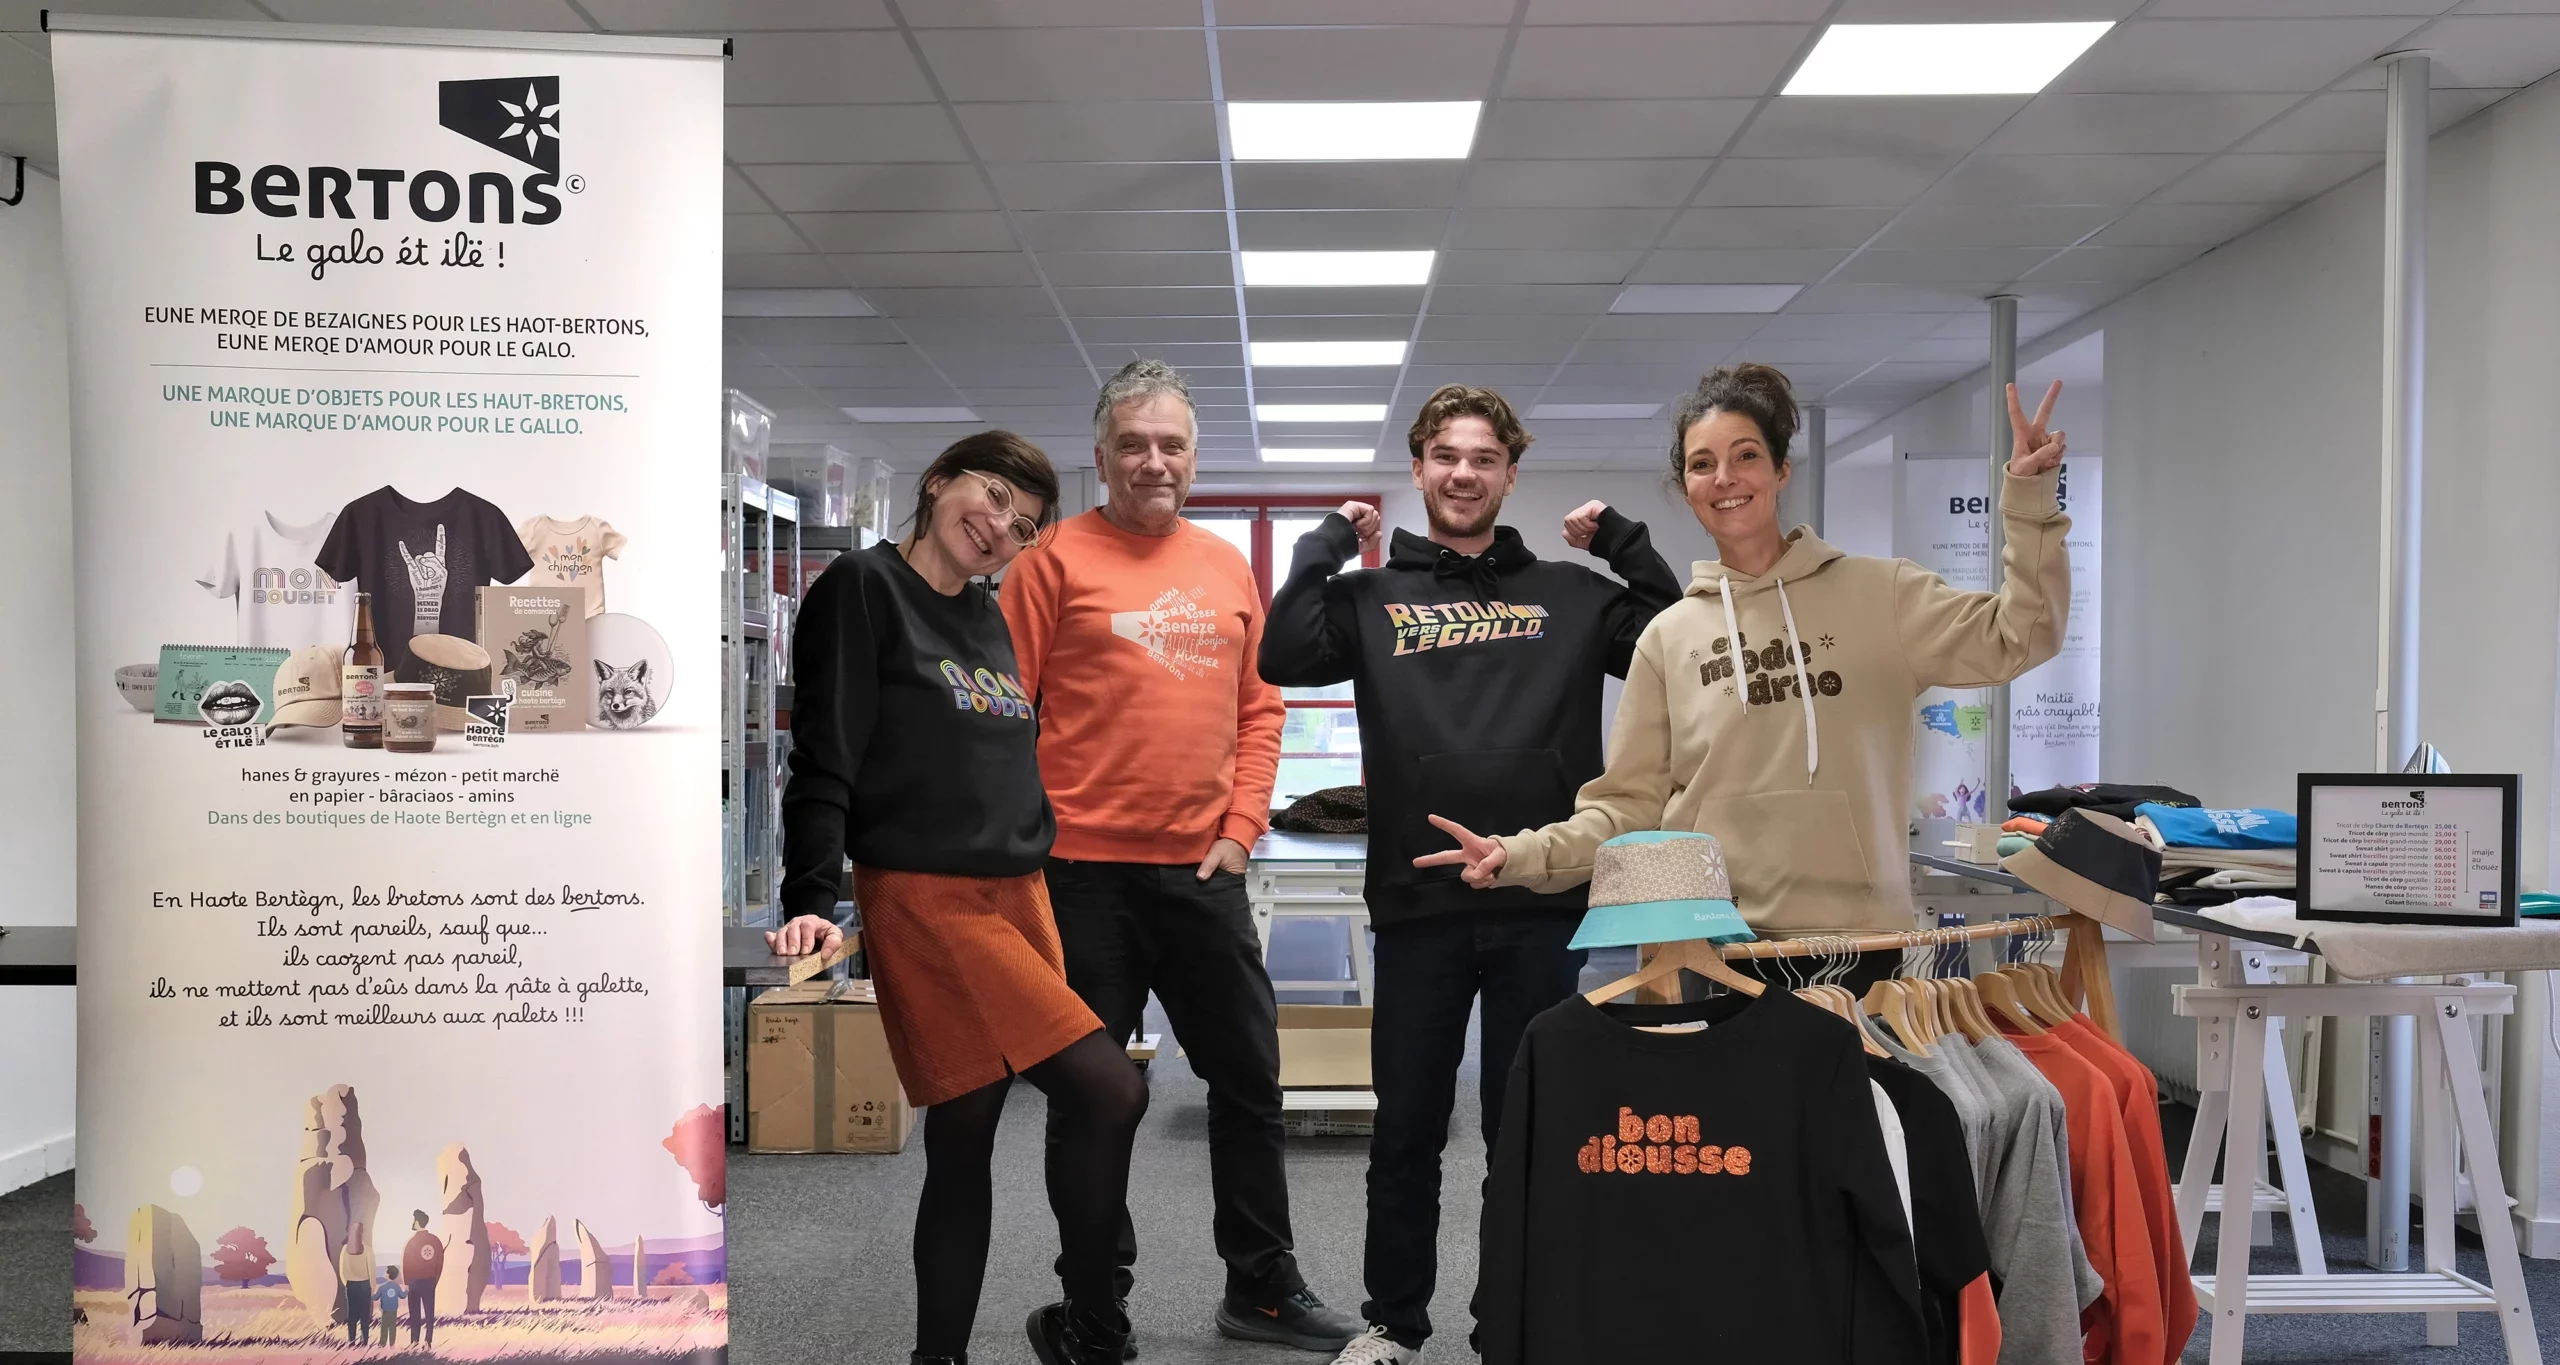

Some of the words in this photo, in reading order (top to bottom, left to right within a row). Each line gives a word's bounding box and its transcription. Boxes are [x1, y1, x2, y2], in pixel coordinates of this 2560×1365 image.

[257, 234, 295, 262] Le
[307, 228, 384, 281] galo
[396, 236, 429, 266] ét
[440, 231, 484, 267] ilë
[145, 307, 194, 323] EUNE
[201, 308, 268, 329] MERQE
[274, 311, 299, 327] DE
[305, 312, 407, 330] BEZAIGNES
[413, 315, 464, 331] POUR
[471, 317, 501, 332] LES
[507, 317, 649, 337] HAOT-BERTONS,
[218, 333, 268, 351] EUNE
[275, 335, 340, 355] MERQE
[440, 340, 491, 356] POUR
[497, 341, 516, 357] LE
[522, 342, 575, 358] GALO.
[163, 385, 202, 401] UNE
[208, 386, 291, 406] MARQUE
[389, 391, 441, 408] POUR
[447, 392, 477, 408] LES
[484, 393, 627, 413] HAUT-BRETONS,
[211, 411, 250, 427] UNE
[256, 412, 337, 432] MARQUE
[438, 416, 489, 433] POUR
[495, 418, 515, 433] LE
[520, 418, 583, 434] GALLO.
[548, 560, 593, 573] chinchon
[560, 554, 583, 562] mon
[253, 567, 337, 590] MON
[253, 589, 337, 605] BOUDET
[509, 596, 561, 608] Recettes
[1149, 586, 1180, 612] amins
[1162, 602, 1197, 619] DRAO
[1383, 601, 1516, 628] RETOUR
[1397, 624, 1442, 639] VERS
[1436, 618, 1542, 649] GALLO
[1175, 649, 1219, 669] HUCHER
[1700, 638, 1812, 687] mode
[521, 688, 553, 697] cuisine
[940, 659, 1030, 701] MON
[1747, 670, 1843, 706] drao
[953, 688, 1035, 721] BOUDET
[2015, 705, 2040, 721] pâs
[242, 768, 289, 781] hanes
[312, 772, 380, 786] grayures
[395, 769, 446, 782] mézon
[462, 769, 498, 786] petit
[503, 769, 559, 782] marchë
[290, 792, 308, 802] en
[314, 789, 365, 806] papier
[380, 789, 453, 802] bâraciaos
[469, 789, 514, 802] amins
[209, 811, 248, 824] Dans
[253, 810, 281, 824] des
[286, 811, 365, 828] boutiques
[370, 811, 389, 824] de
[395, 811, 440, 824] Haote
[446, 811, 506, 828] Bertègn
[511, 813, 526, 824] et
[531, 814, 549, 824] en
[554, 811, 591, 828] ligne
[153, 892, 183, 908] En
[191, 891, 248, 907] Haote
[256, 890, 343, 916] Bertègn,
[352, 885, 380, 906] les
[386, 885, 464, 906] bretons
[470, 889, 518, 905] sont
[525, 887, 555, 905] des
[561, 885, 644, 912] bertons.
[257, 916, 287, 936] Ils
[294, 920, 343, 936] sont
[350, 915, 431, 943] pareils,
[439, 914, 490, 945] sauf
[496, 924, 547, 942] que...
[283, 945, 309, 966] ils
[316, 949, 397, 975] caozent
[404, 953, 444, 972] pas
[451, 943, 522, 972] pareil,
[149, 977, 176, 998] ils
[182, 986, 209, 997] ne
[215, 980, 301, 997] mettent
[308, 983, 349, 1003] pas
[356, 976, 408, 995] d'eûs
[415, 977, 468, 994] dans
[475, 973, 498, 994] la
[505, 977, 551, 1000] pâte
[558, 977, 571, 993] à
[577, 972, 648, 1003] galette,
[219, 1010, 239, 1027] et
[245, 1005, 272, 1026] ils
[279, 1009, 328, 1026] sont
[334, 1004, 436, 1025] meilleurs
[443, 1013, 486, 1023] aux
[492, 1002, 558, 1030] palets
[1618, 1106, 1701, 1144] bon
[1577, 1134, 1752, 1176] diousse
